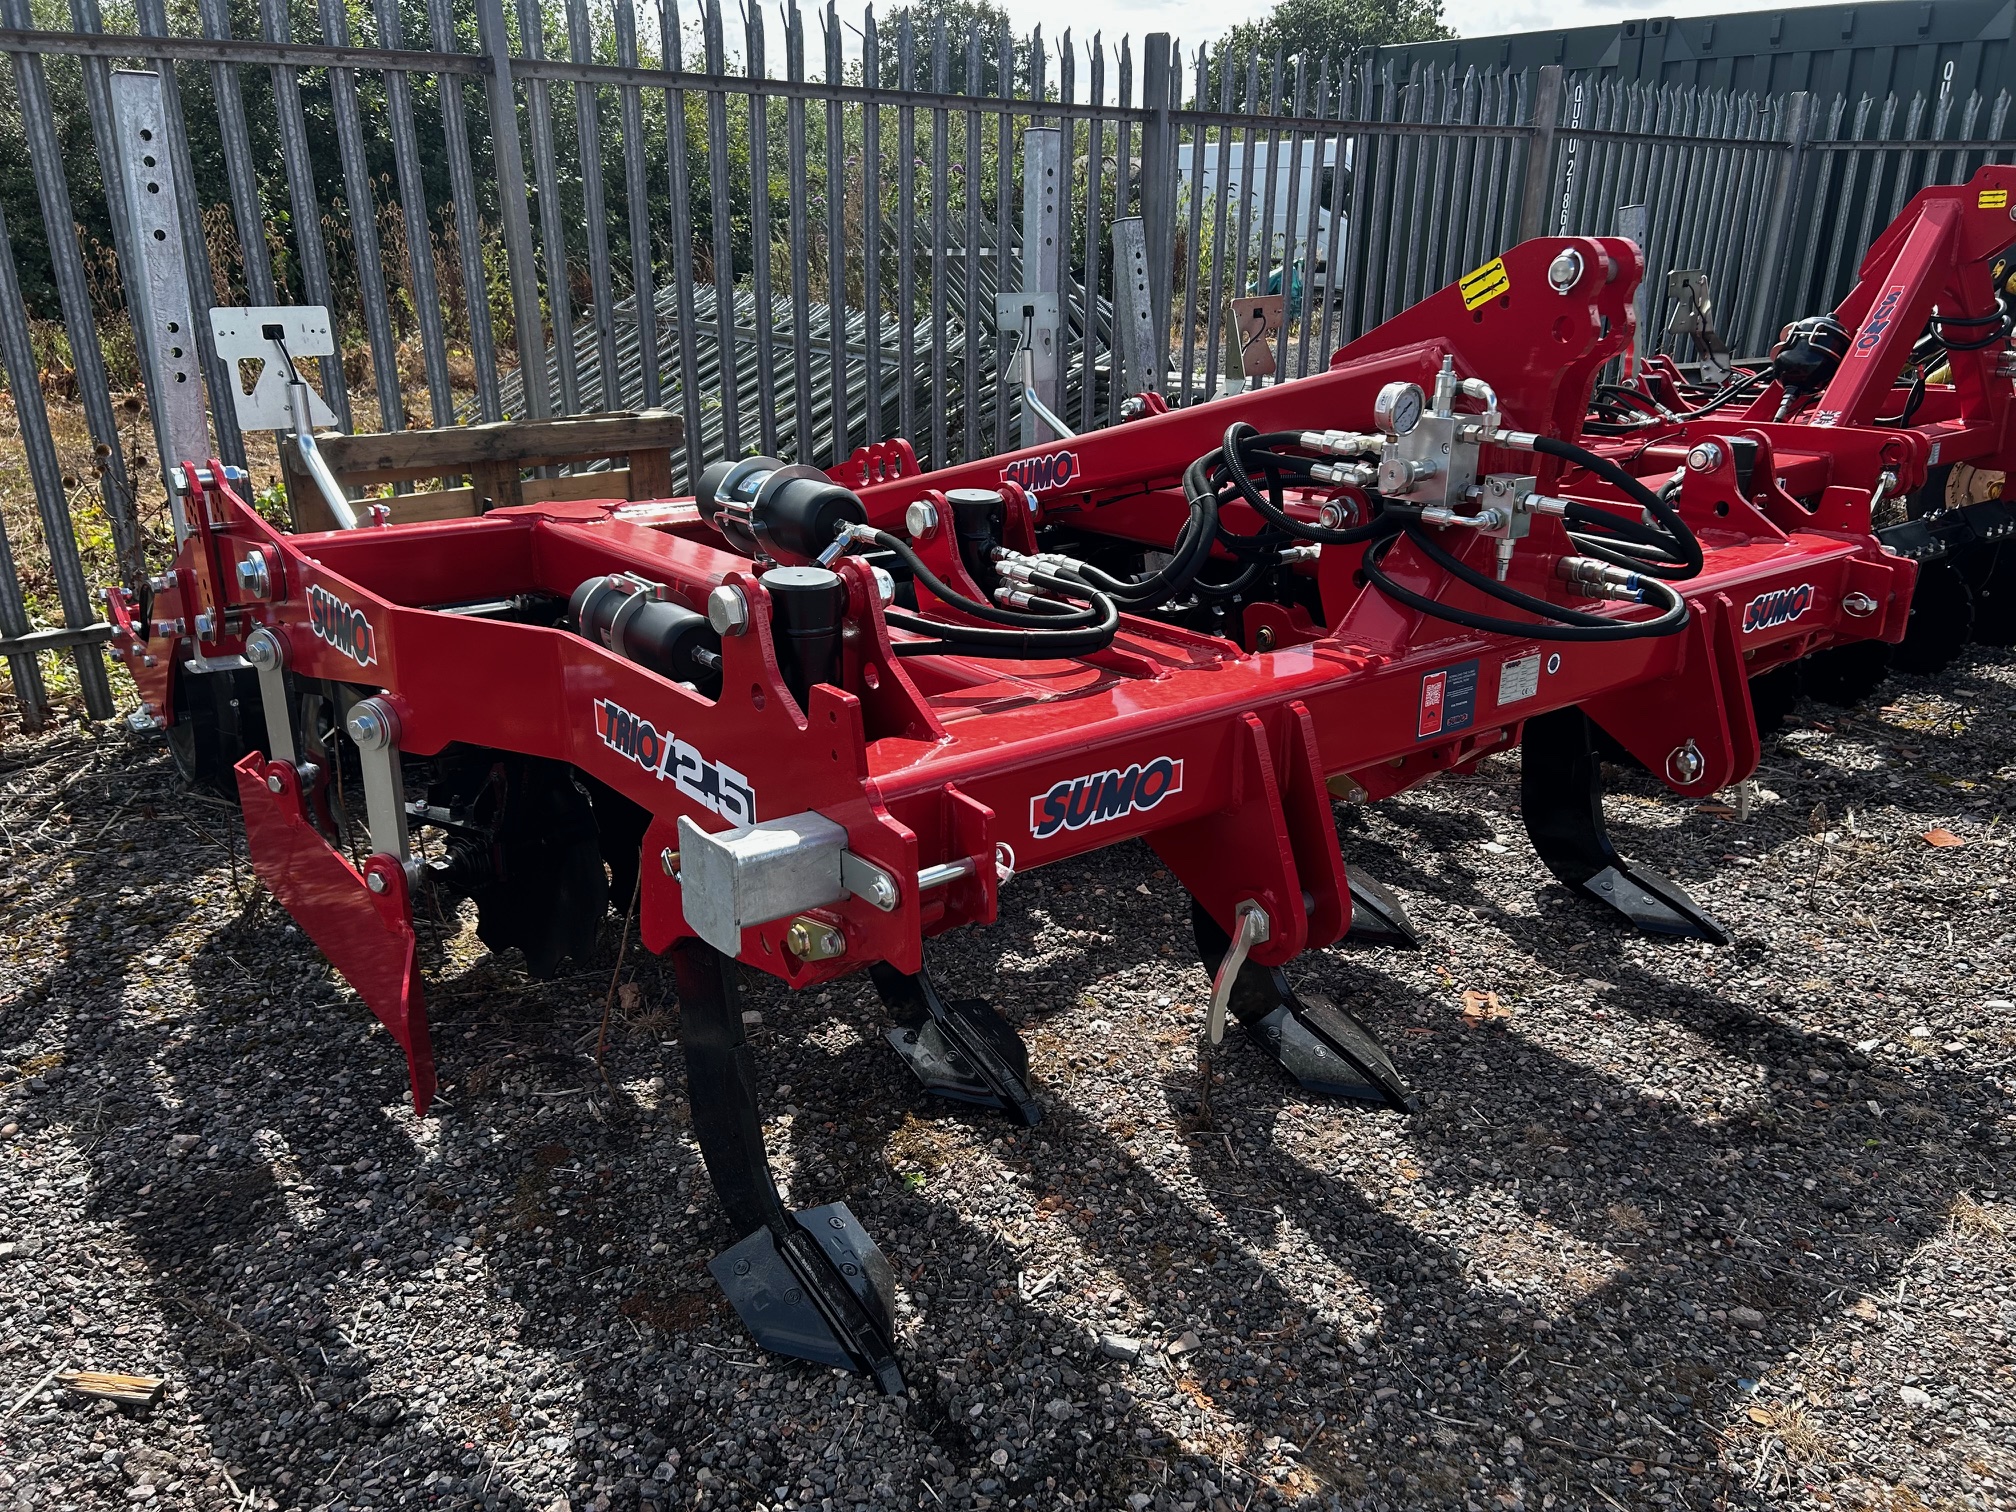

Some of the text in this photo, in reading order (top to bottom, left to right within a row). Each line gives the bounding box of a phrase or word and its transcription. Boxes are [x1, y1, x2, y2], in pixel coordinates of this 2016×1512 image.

[1857, 290, 1902, 349] SUMO
[1004, 450, 1076, 491] SUMO
[309, 583, 373, 667] SUMO
[1743, 583, 1811, 633] SUMO
[1033, 756, 1177, 838] SUMO
